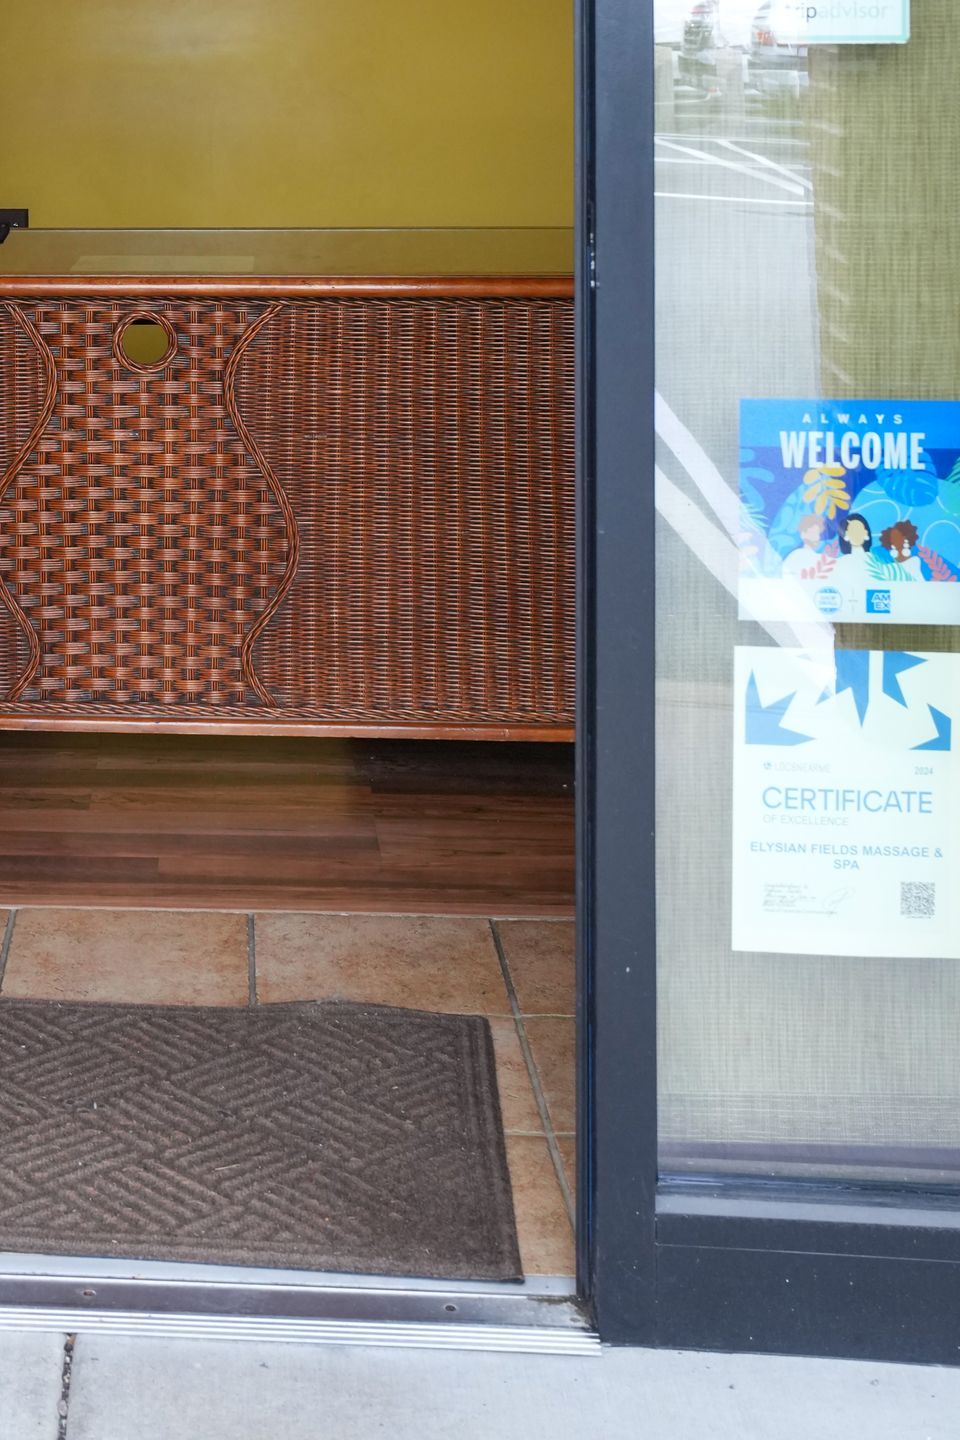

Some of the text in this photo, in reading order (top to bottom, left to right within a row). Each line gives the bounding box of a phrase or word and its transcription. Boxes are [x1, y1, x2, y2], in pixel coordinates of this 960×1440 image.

[802, 413, 903, 425] ALWAYS
[779, 431, 926, 470] WELCOME
[762, 786, 933, 814] CERTIFICATE
[763, 814, 849, 827] OF EXCELLENCE
[750, 841, 943, 858] ELYSIAN FIELDS MASSAGE &
[833, 859, 860, 870] SPA
